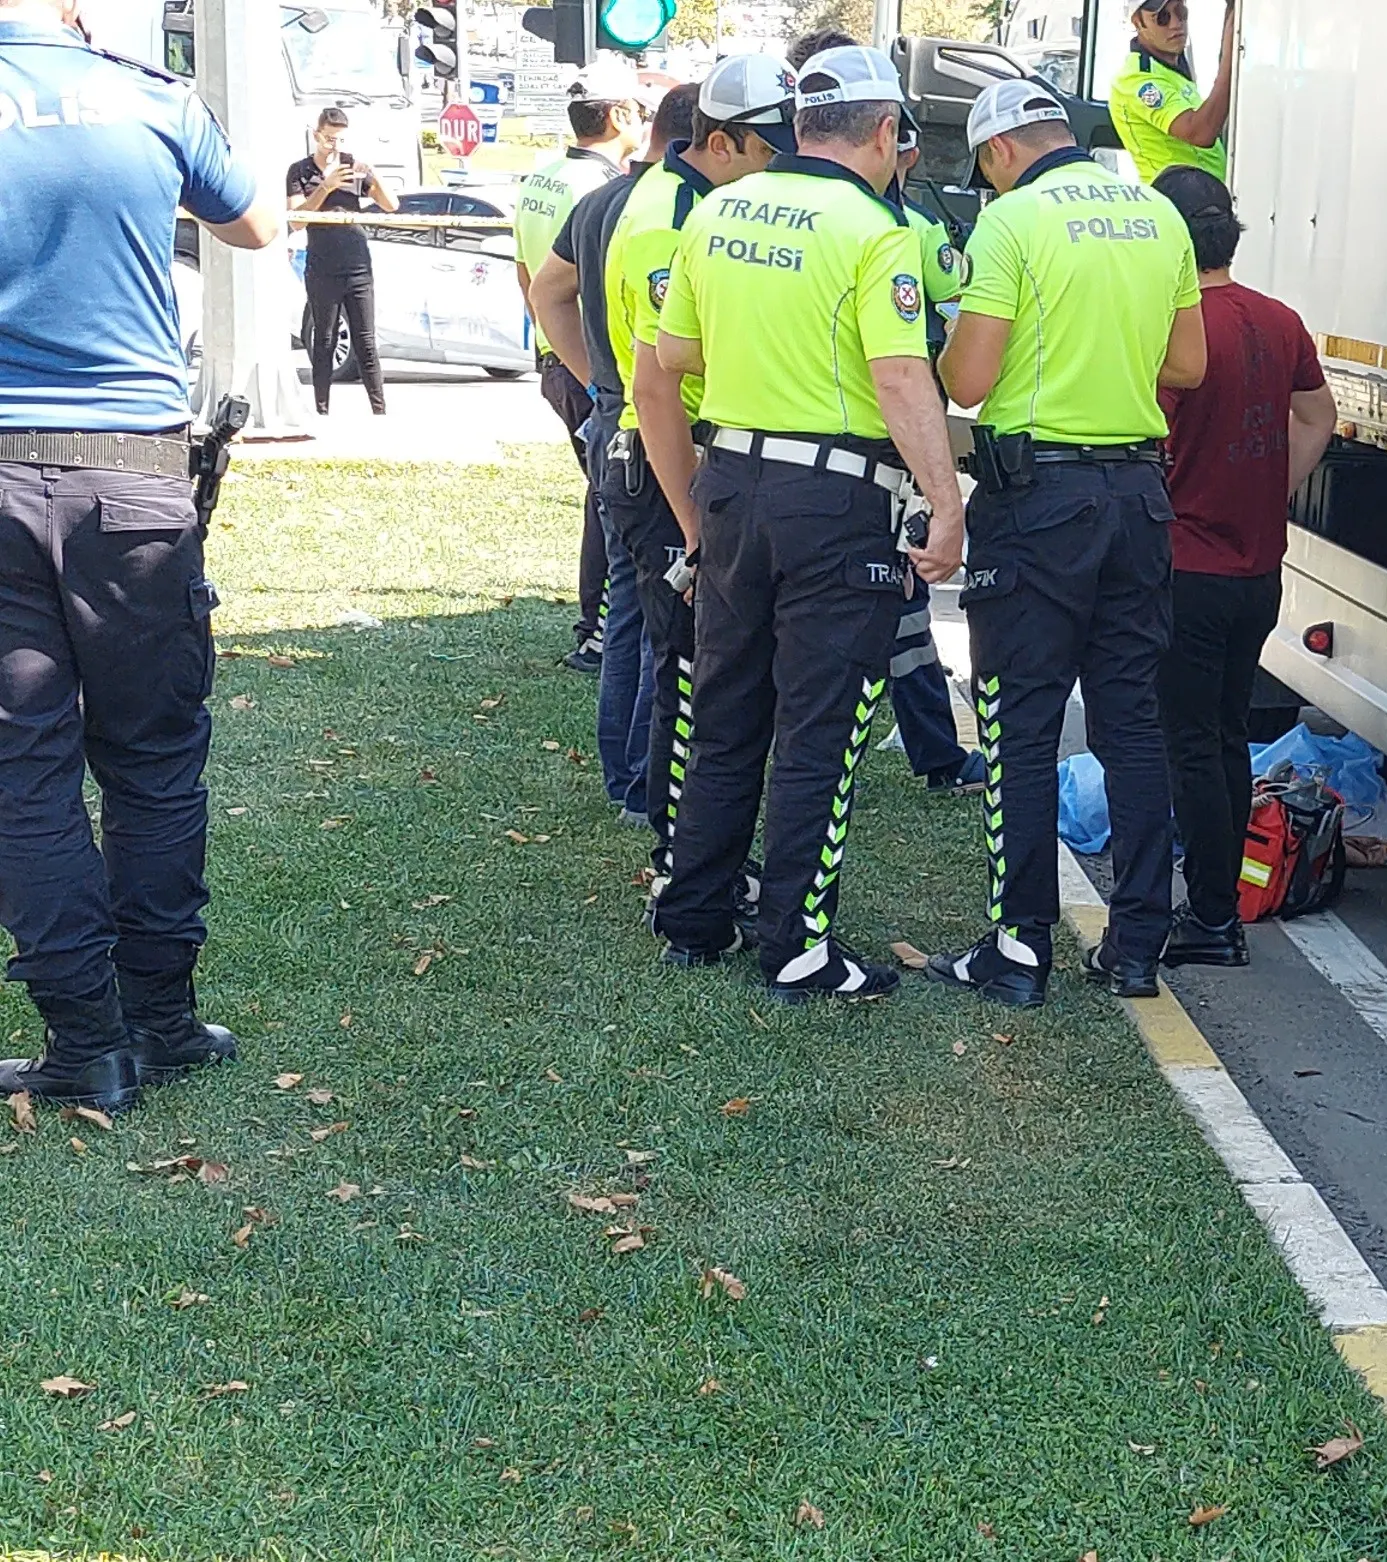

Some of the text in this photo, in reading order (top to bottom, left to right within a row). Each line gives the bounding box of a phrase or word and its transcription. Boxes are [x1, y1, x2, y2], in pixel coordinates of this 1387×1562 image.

[442, 118, 479, 143] DUR
[1040, 184, 1152, 204] TRAFİK
[718, 198, 823, 232] TRAFİK
[1066, 217, 1159, 243] POLİSİ
[707, 235, 803, 272] POLİSİ
